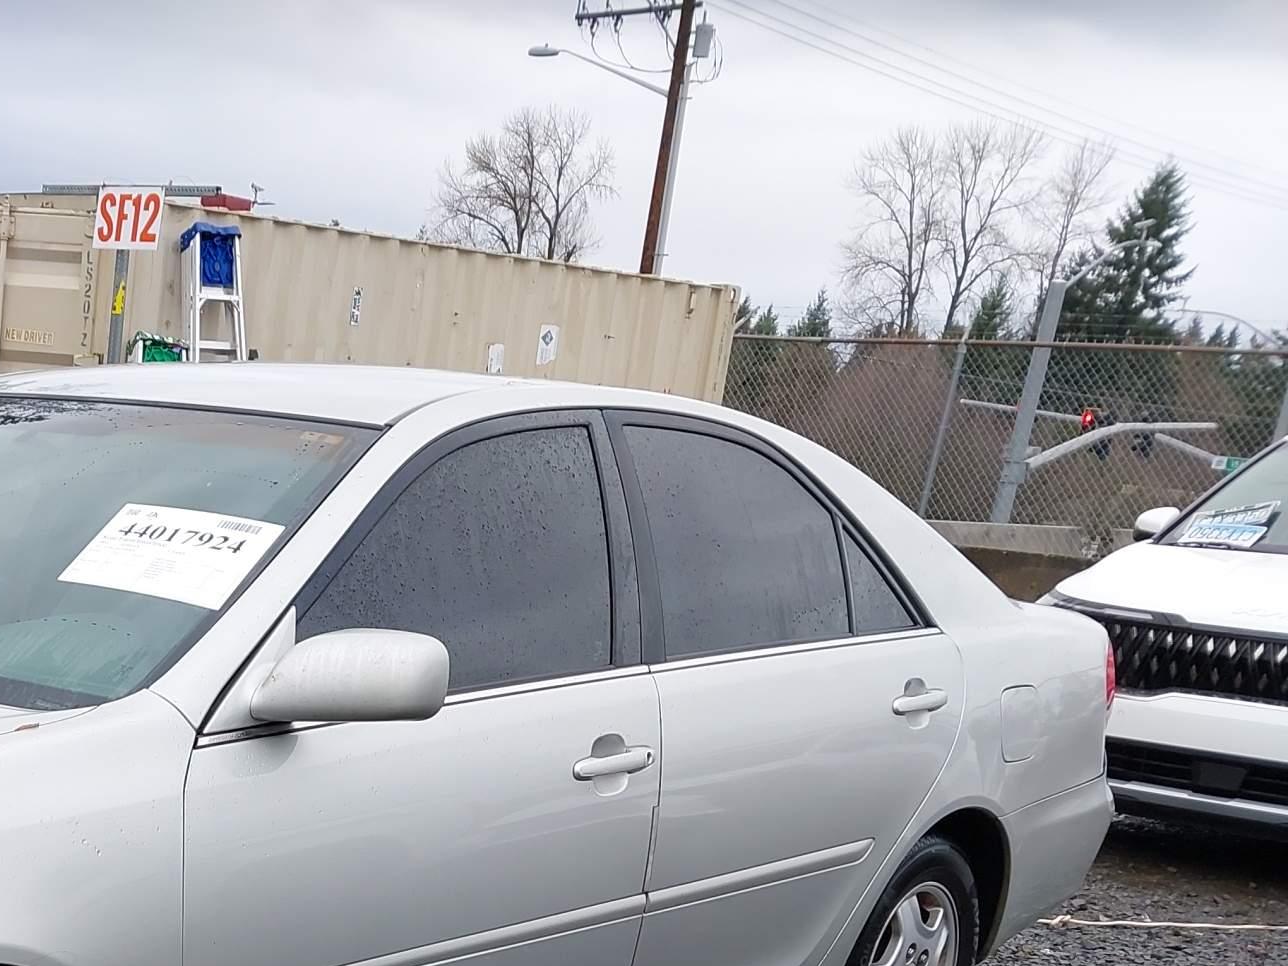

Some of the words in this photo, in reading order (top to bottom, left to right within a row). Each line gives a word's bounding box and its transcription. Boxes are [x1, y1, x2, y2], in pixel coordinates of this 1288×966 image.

[97, 192, 161, 243] SF12
[5, 328, 23, 341] NEW
[24, 329, 55, 345] DRIVER
[118, 522, 248, 554] 44017924
